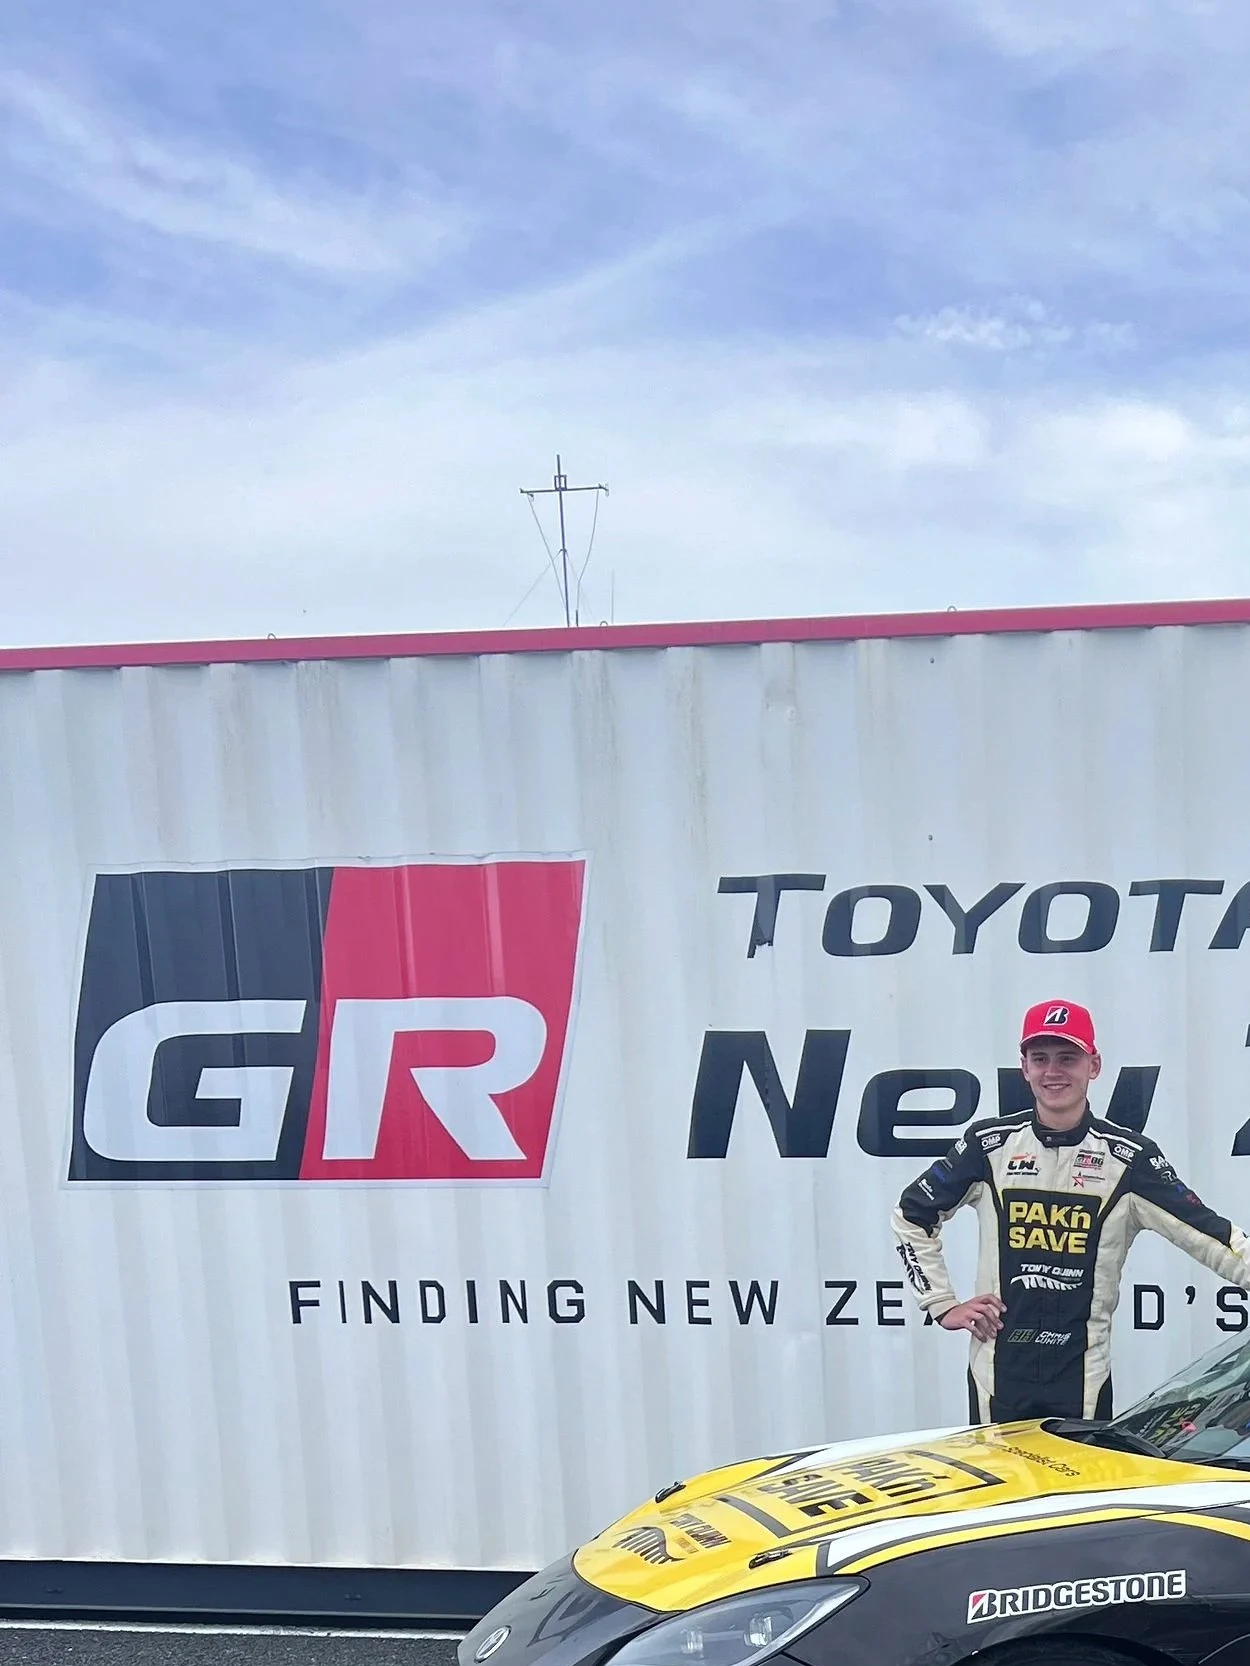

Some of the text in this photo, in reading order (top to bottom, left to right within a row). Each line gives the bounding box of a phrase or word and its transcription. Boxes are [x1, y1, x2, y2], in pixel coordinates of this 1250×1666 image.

[83, 996, 527, 1161] GR
[981, 1134, 1001, 1148] OMP
[1113, 1145, 1135, 1159] OMP
[1008, 1226, 1089, 1254] SAVE
[1020, 1263, 1084, 1278] TONY QUINN
[288, 1279, 586, 1324] FINDING
[627, 1280, 779, 1325] NEW
[825, 1281, 1249, 1333] ZED'S
[757, 1473, 874, 1518] SAVE
[970, 1573, 1183, 1621] BRIDGESTONE
